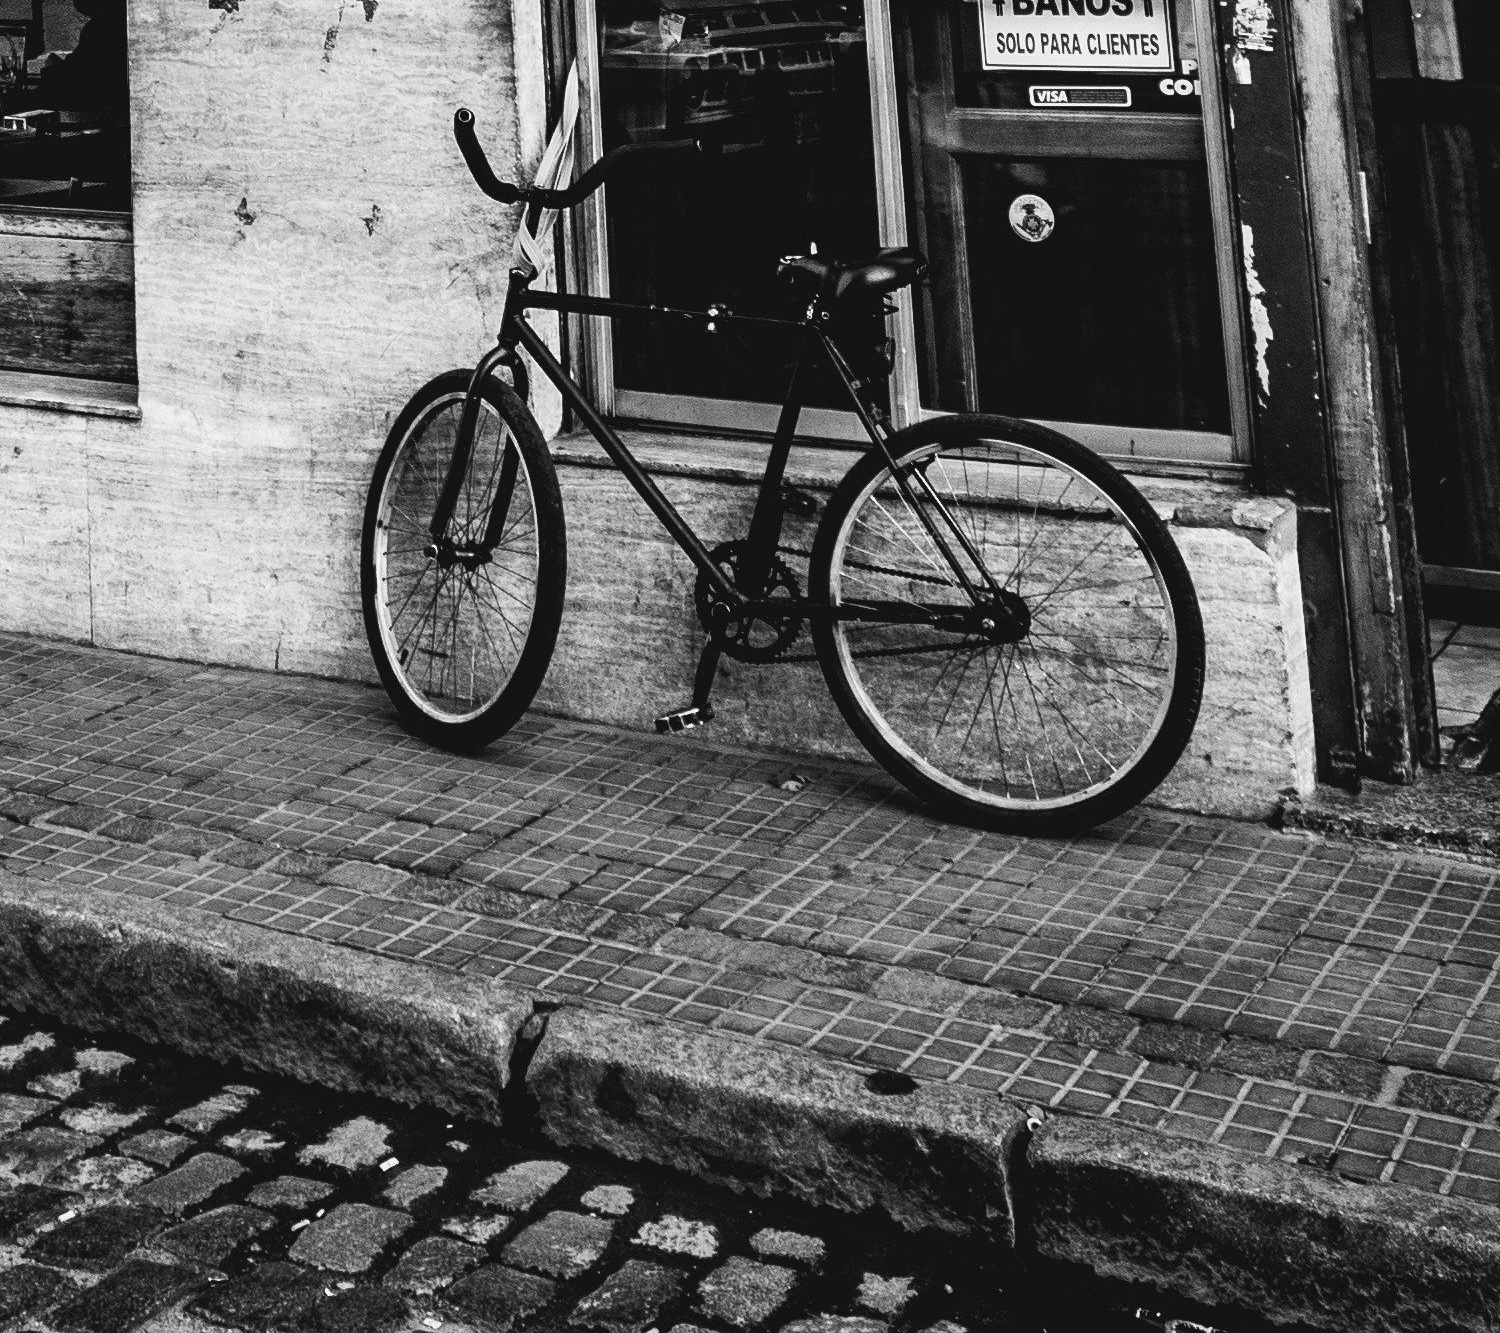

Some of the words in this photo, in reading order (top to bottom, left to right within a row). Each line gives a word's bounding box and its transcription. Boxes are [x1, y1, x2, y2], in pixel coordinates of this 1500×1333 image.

[996, 32, 1036, 54] SOLO
[1041, 33, 1083, 55] PARA
[1087, 33, 1160, 56] CLIENTES
[1035, 90, 1069, 104] VISA
